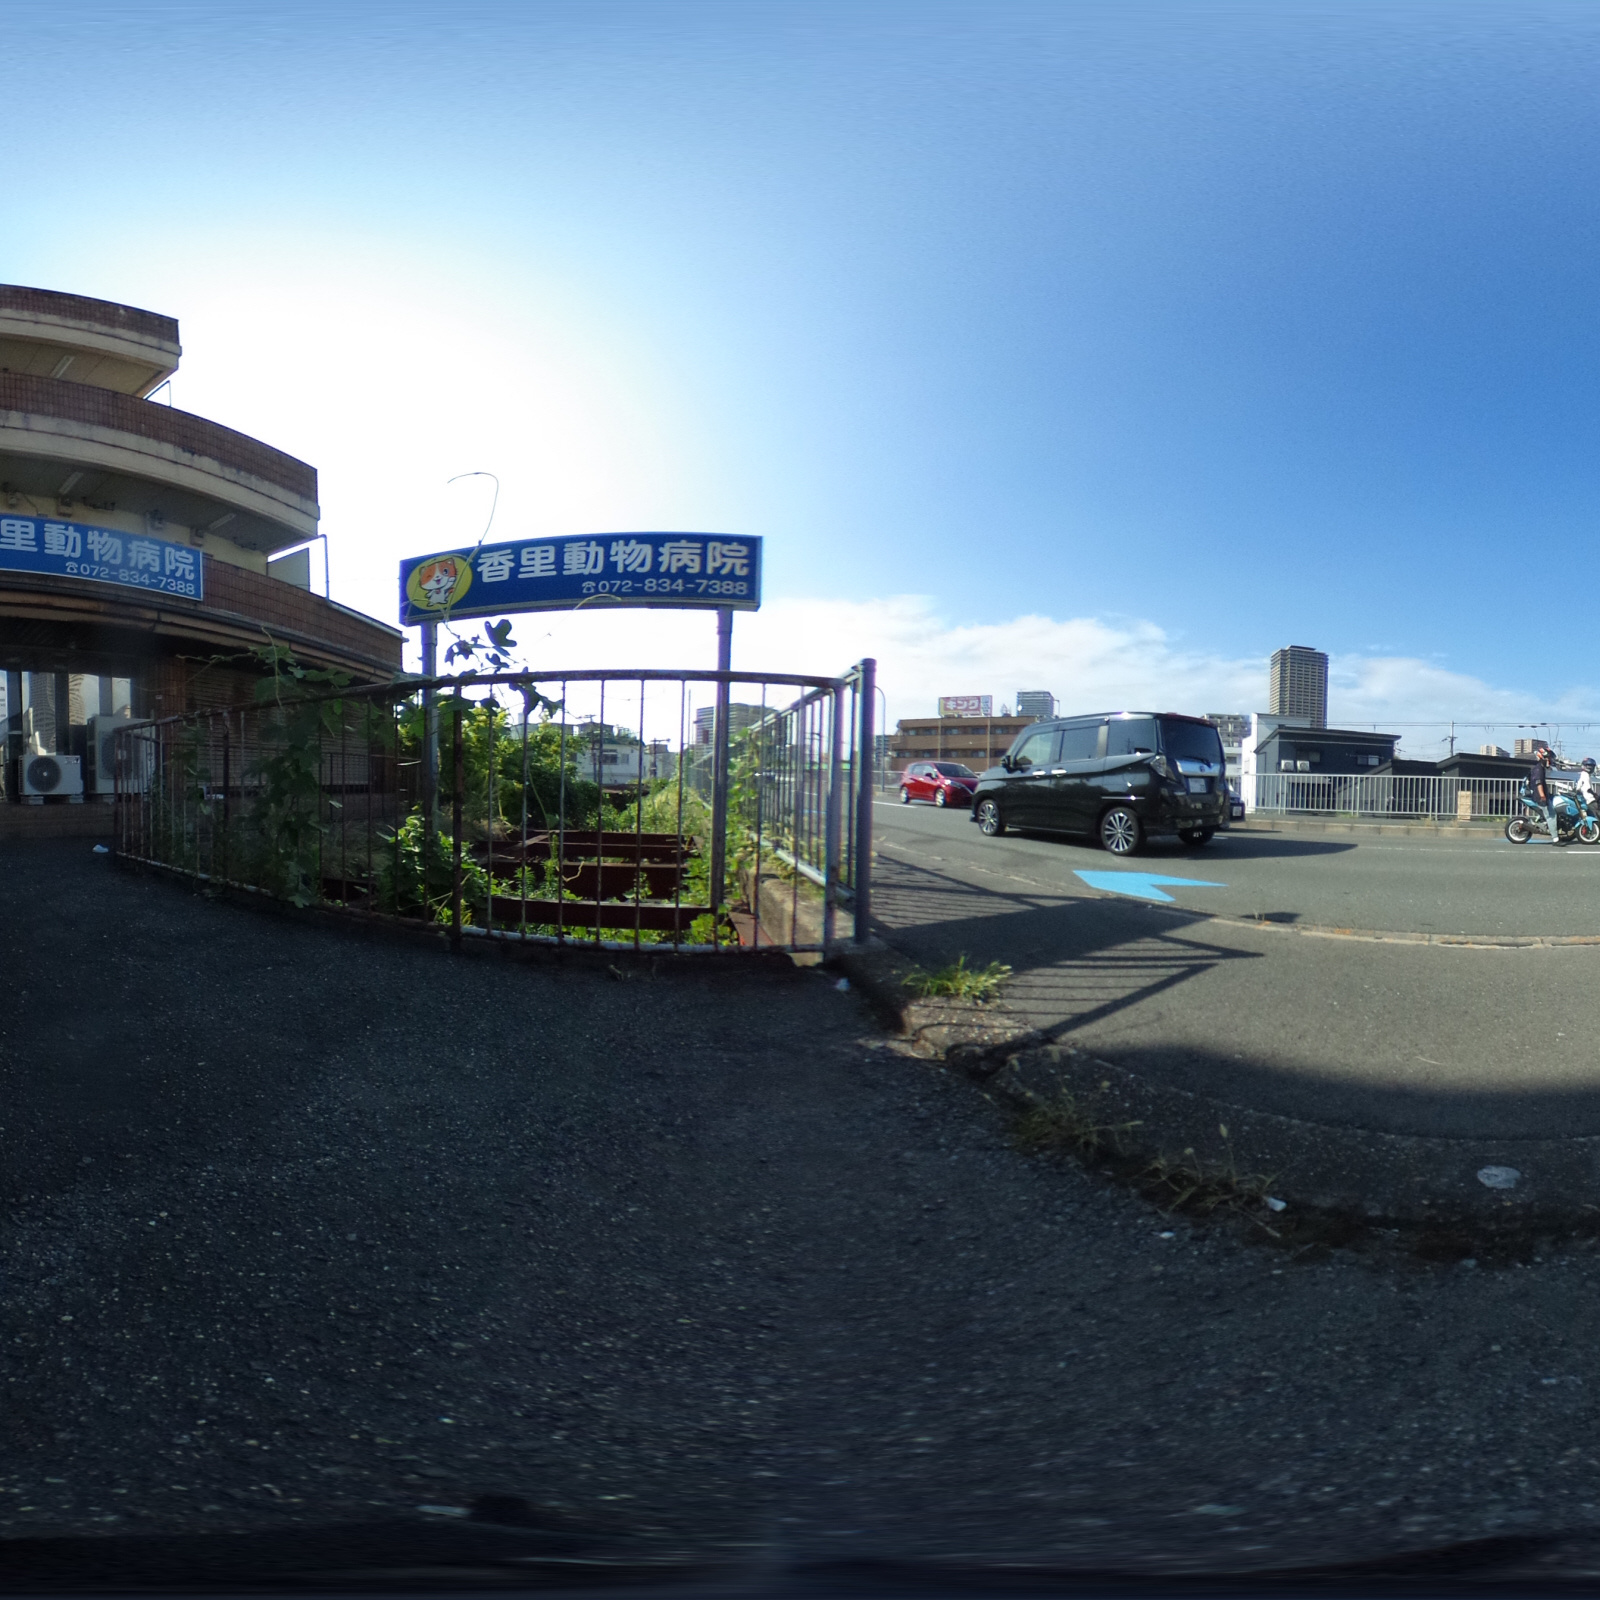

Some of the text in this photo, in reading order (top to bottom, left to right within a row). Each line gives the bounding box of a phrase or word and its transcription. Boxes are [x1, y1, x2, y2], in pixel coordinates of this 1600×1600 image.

[0, 518, 196, 581] 里動物病院
[476, 539, 750, 583] 香里動物病院
[80, 562, 196, 596] 072-834-7388
[597, 578, 748, 596] 072-834-7388
